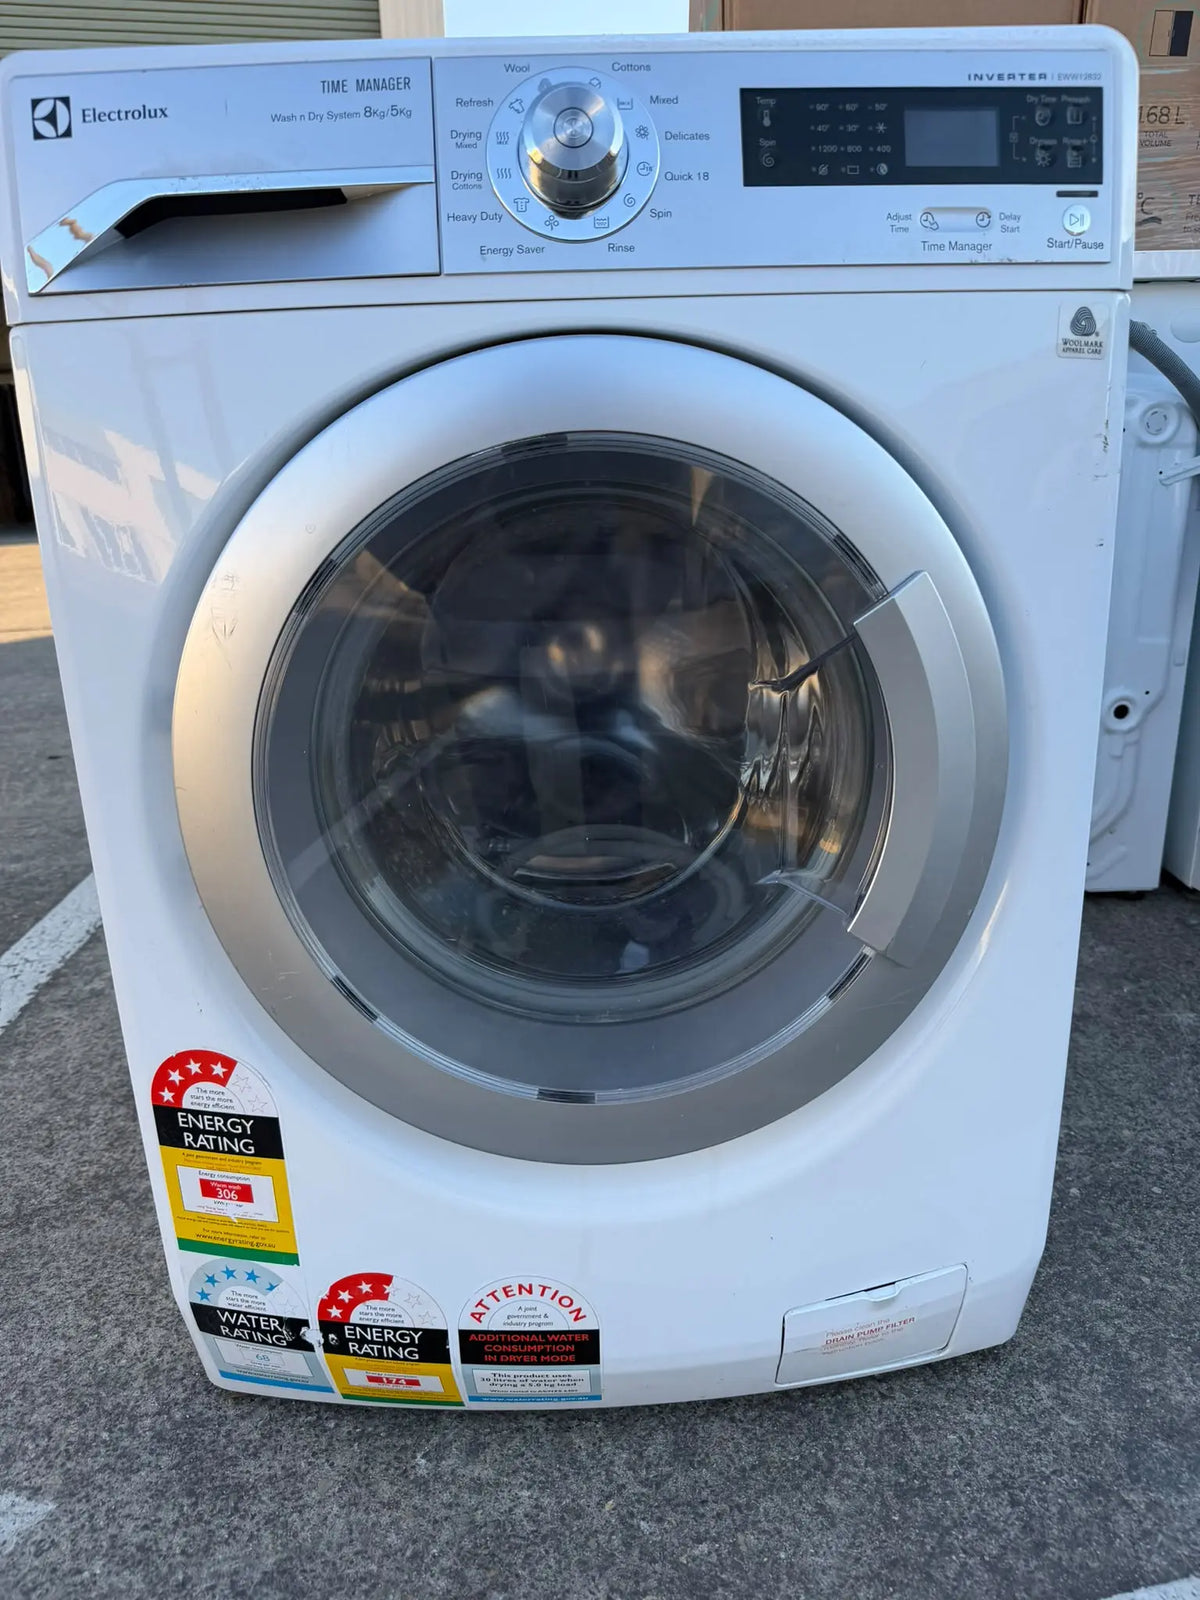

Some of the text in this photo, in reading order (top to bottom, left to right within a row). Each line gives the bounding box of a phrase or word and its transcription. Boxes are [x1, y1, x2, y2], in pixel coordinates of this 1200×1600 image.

[504, 64, 530, 73] Wool
[612, 62, 651, 72] Cottons
[967, 73, 1047, 81] INVERTER
[320, 76, 411, 94] TIME MANAGER
[456, 98, 494, 108] Refresh
[650, 96, 678, 105] Mixed
[756, 96, 776, 108] Temp
[82, 105, 168, 124] Electrolux
[270, 113, 296, 122] Wash
[308, 112, 324, 123] Dry
[326, 110, 360, 122] System
[364, 104, 412, 120] 8Kg/5Kg
[1175, 106, 1185, 124] L
[450, 130, 482, 141] Drying
[664, 131, 710, 141] Delicates
[1144, 130, 1168, 138] TOTAL
[759, 138, 776, 148] Spin
[1140, 140, 1172, 148] VOLUME
[451, 170, 482, 182] Drying
[664, 172, 710, 182] Quick 18
[452, 182, 482, 190] Cottons
[447, 212, 503, 224] Heavy Duty
[650, 208, 672, 219] Spin
[886, 212, 912, 222] Adjust
[1000, 212, 1021, 222] Delay
[890, 225, 909, 233] Time
[1000, 225, 1020, 233] Start
[608, 243, 635, 253] Rinse
[921, 240, 992, 254] Time Manager
[1046, 237, 1104, 250] Start/Pause
[480, 245, 545, 256] Energy Saver
[1062, 338, 1104, 348] WOOLMARK
[196, 1086, 208, 1094] The
[177, 1112, 254, 1134] ENERGY
[184, 1132, 255, 1154] RATING
[198, 1170, 216, 1179] Energy
[216, 1188, 238, 1200] 306
[470, 1283, 587, 1324] ATTENTION
[216, 1309, 282, 1332] WATER
[220, 1325, 287, 1346] RATING
[344, 1325, 423, 1344] ENERGY
[825, 1334, 855, 1345] DRAIN
[856, 1327, 884, 1338] PUMP
[885, 1316, 915, 1330] FILTER
[469, 1334, 589, 1342] ADDITIONAL WATER
[348, 1342, 419, 1360] RATING
[484, 1344, 575, 1352] CONSUMPTION
[382, 1377, 407, 1385] 174
